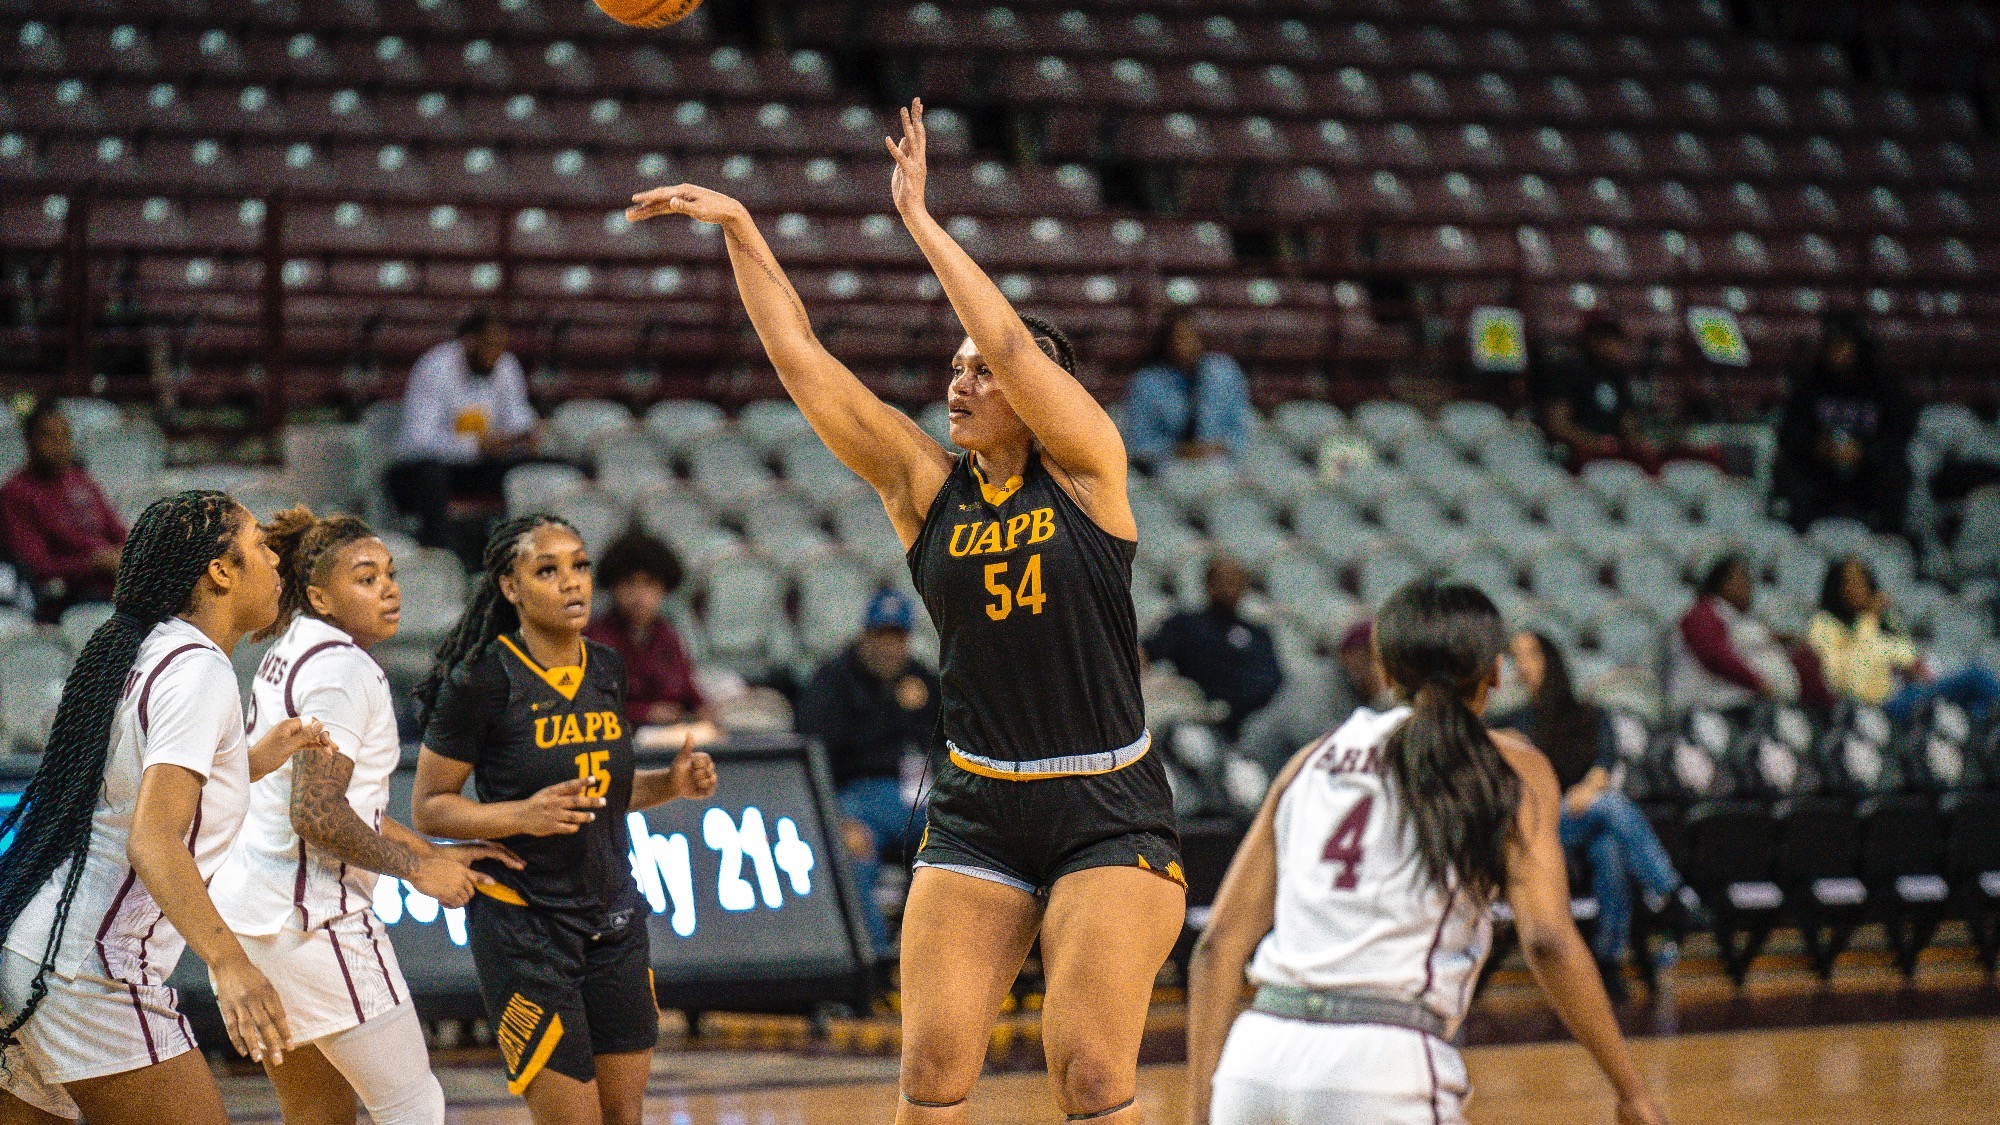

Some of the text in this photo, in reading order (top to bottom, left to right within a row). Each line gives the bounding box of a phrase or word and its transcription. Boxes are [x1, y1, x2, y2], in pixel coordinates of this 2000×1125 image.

[949, 507, 1056, 557] UAPB
[984, 553, 1047, 621] 54
[534, 711, 622, 749] UAPB
[574, 750, 612, 799] 15
[703, 807, 814, 911] 21+
[1320, 795, 1374, 890] 4
